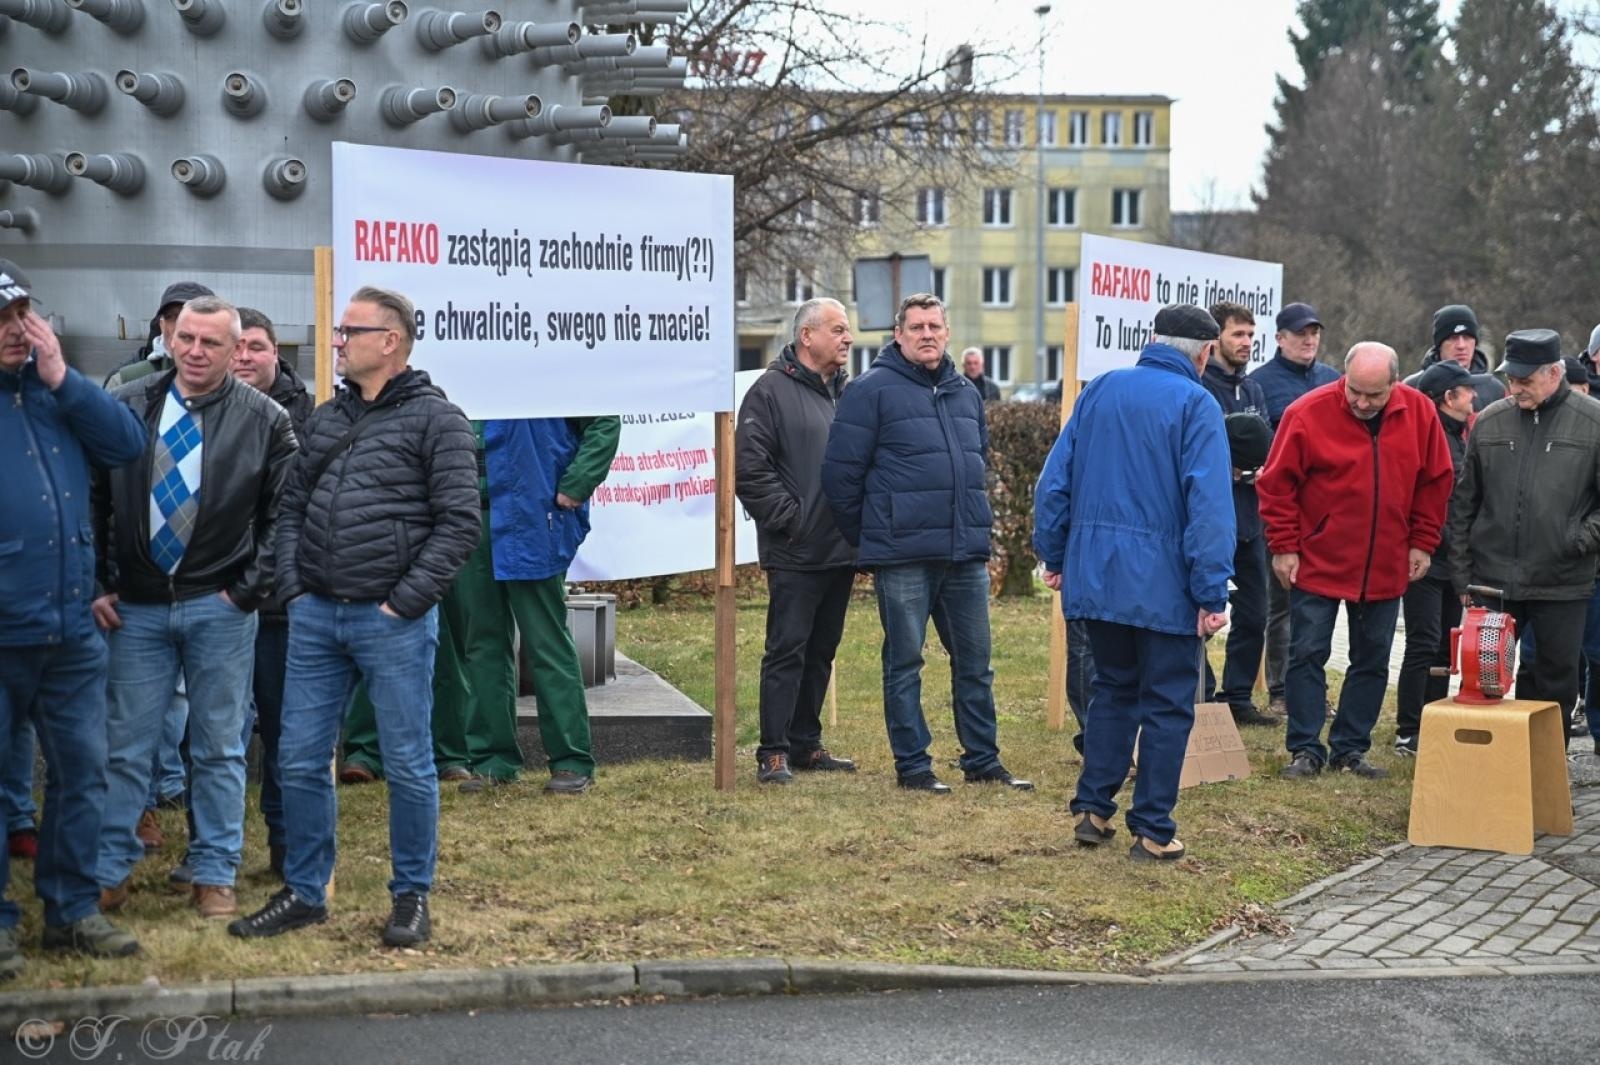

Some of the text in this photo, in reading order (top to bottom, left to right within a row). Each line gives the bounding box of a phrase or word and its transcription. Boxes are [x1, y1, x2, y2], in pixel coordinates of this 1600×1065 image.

[354, 219, 714, 282] RAFAKO zastąpią zachodnie firmy(?!)
[1091, 261, 1274, 317] RAFAKO to nie ideologia!
[434, 301, 539, 347] chwalicie,
[547, 310, 607, 350] swego
[614, 304, 642, 342] nie
[648, 305, 711, 342] znacie!
[1095, 315, 1111, 349] To
[638, 447, 708, 471] atrakcyjnym
[613, 480, 671, 506] atrakcyjnym
